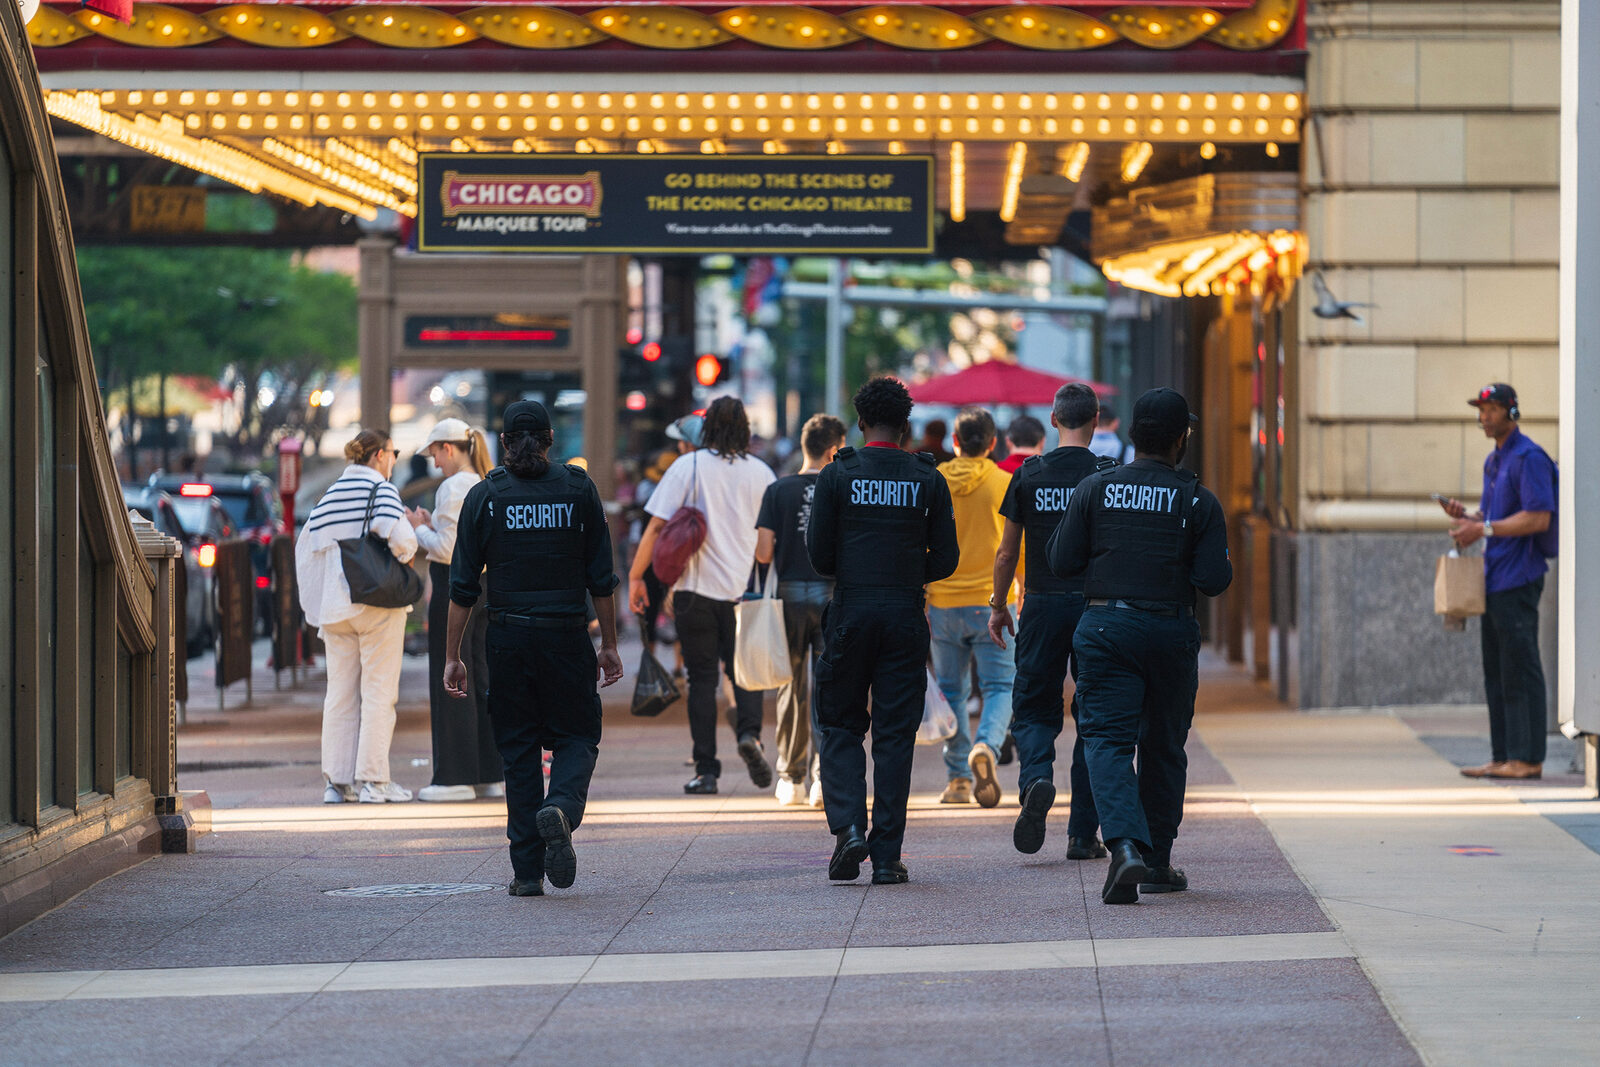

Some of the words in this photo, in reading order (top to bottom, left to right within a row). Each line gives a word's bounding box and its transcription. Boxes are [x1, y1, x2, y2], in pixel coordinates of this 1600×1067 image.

[664, 173, 692, 189] GO
[694, 173, 762, 189] BEHIND
[763, 173, 798, 189] THE
[800, 173, 866, 189] SCENES
[868, 173, 894, 189] OF
[459, 184, 584, 205] CHICAGO
[646, 196, 680, 211] THE
[683, 196, 745, 211] ICONIC
[747, 196, 829, 211] CHICAGO
[831, 196, 912, 211] THEATRE!
[456, 217, 538, 234] MARQUEE
[541, 217, 587, 232] TOUR
[851, 479, 920, 507] SECURITY
[1104, 483, 1178, 513] SECURITY
[506, 503, 574, 529] SECURITY
